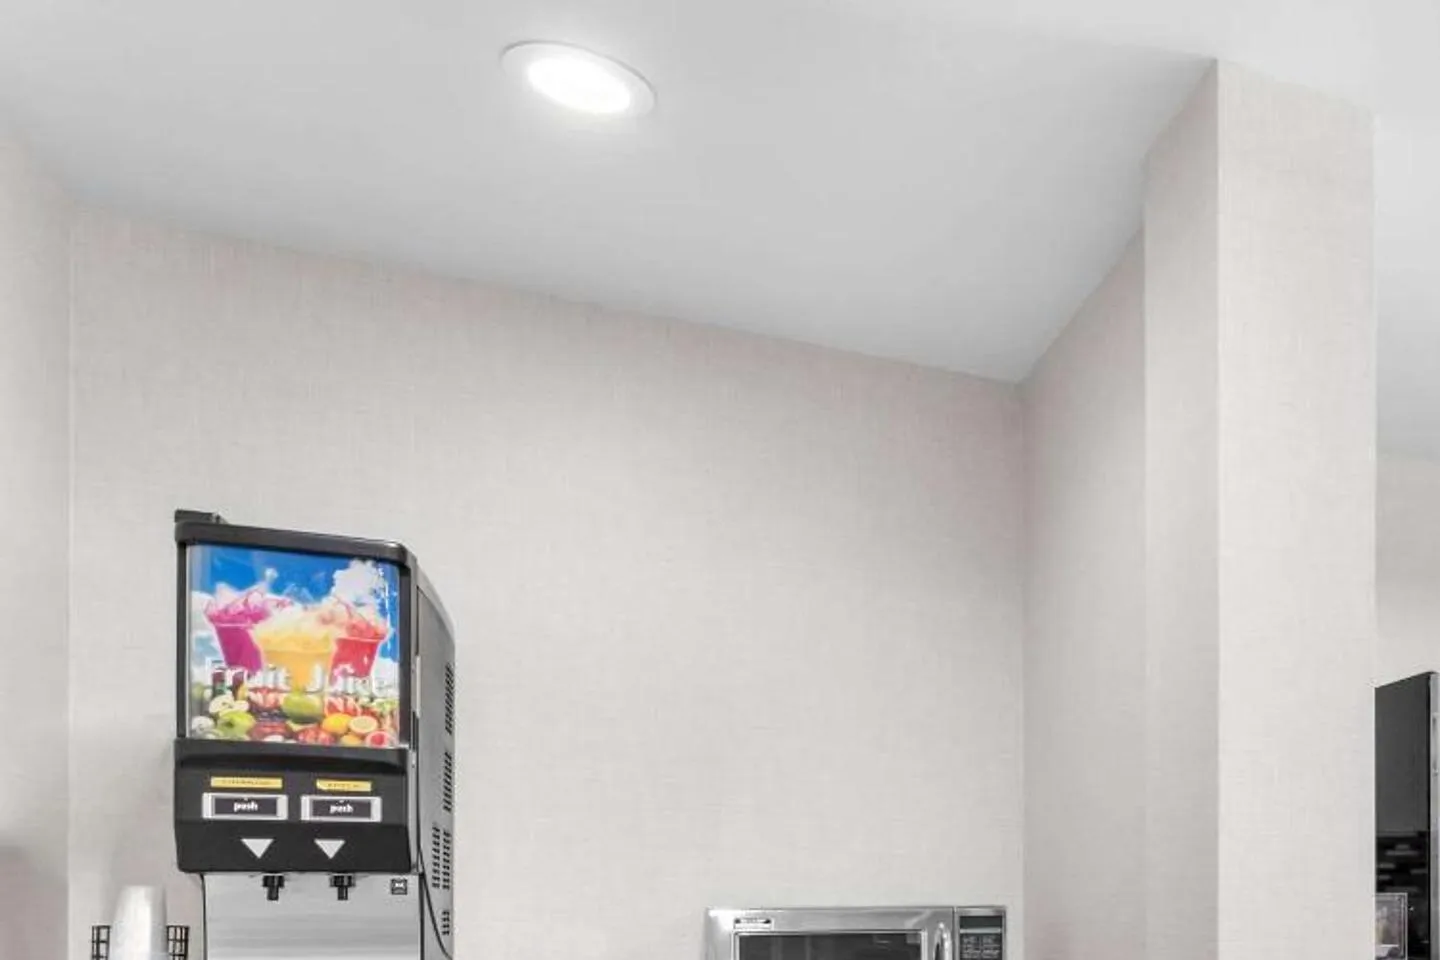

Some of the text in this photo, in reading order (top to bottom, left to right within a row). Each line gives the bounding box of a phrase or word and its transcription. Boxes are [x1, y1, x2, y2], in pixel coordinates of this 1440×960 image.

[205, 657, 291, 697] Fruit
[233, 800, 259, 812] push
[329, 804, 354, 815] push
